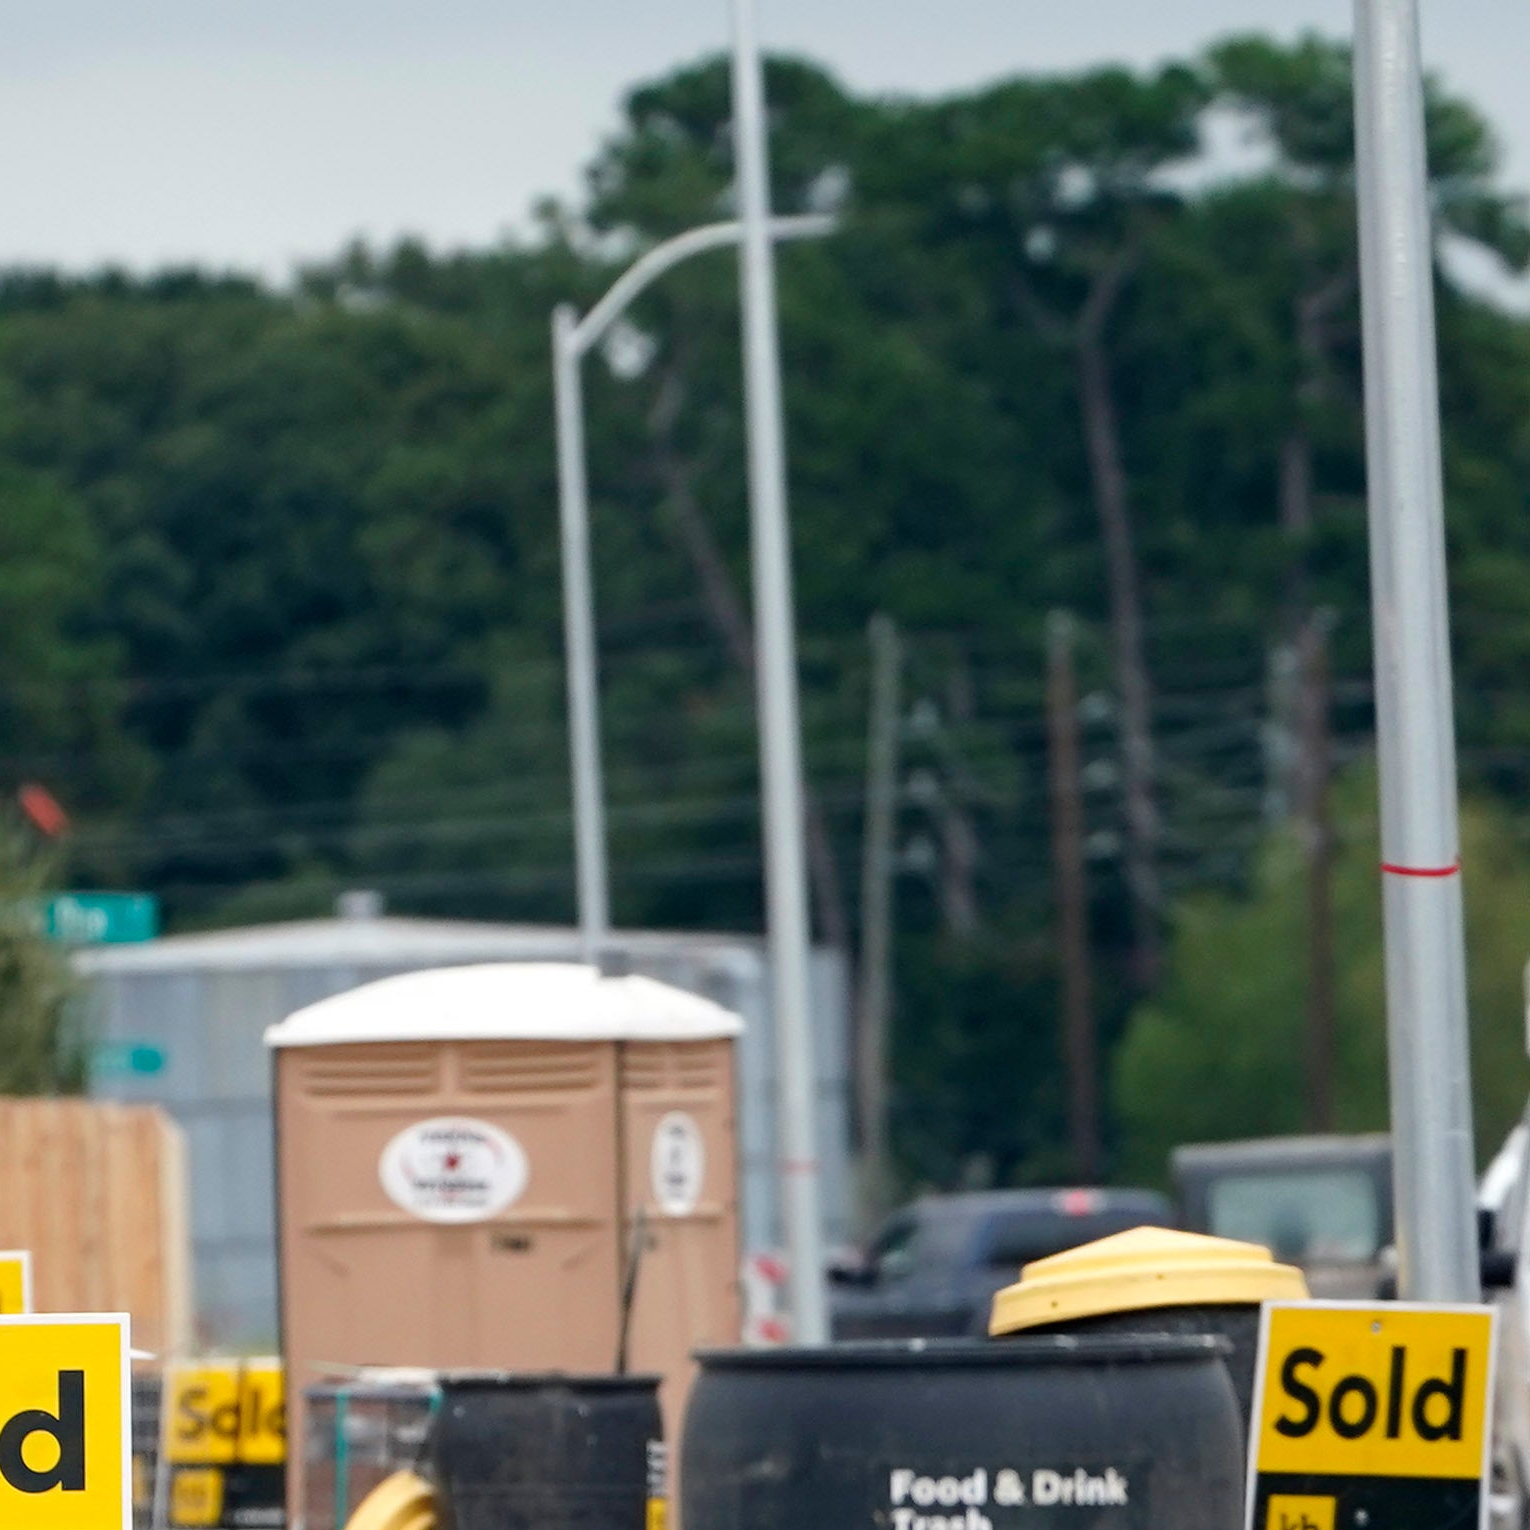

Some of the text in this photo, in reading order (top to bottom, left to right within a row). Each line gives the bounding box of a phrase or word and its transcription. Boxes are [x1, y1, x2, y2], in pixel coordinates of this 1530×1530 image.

[1274, 1346, 1468, 1442] Sold
[890, 1467, 1129, 1506] Food & Drink
